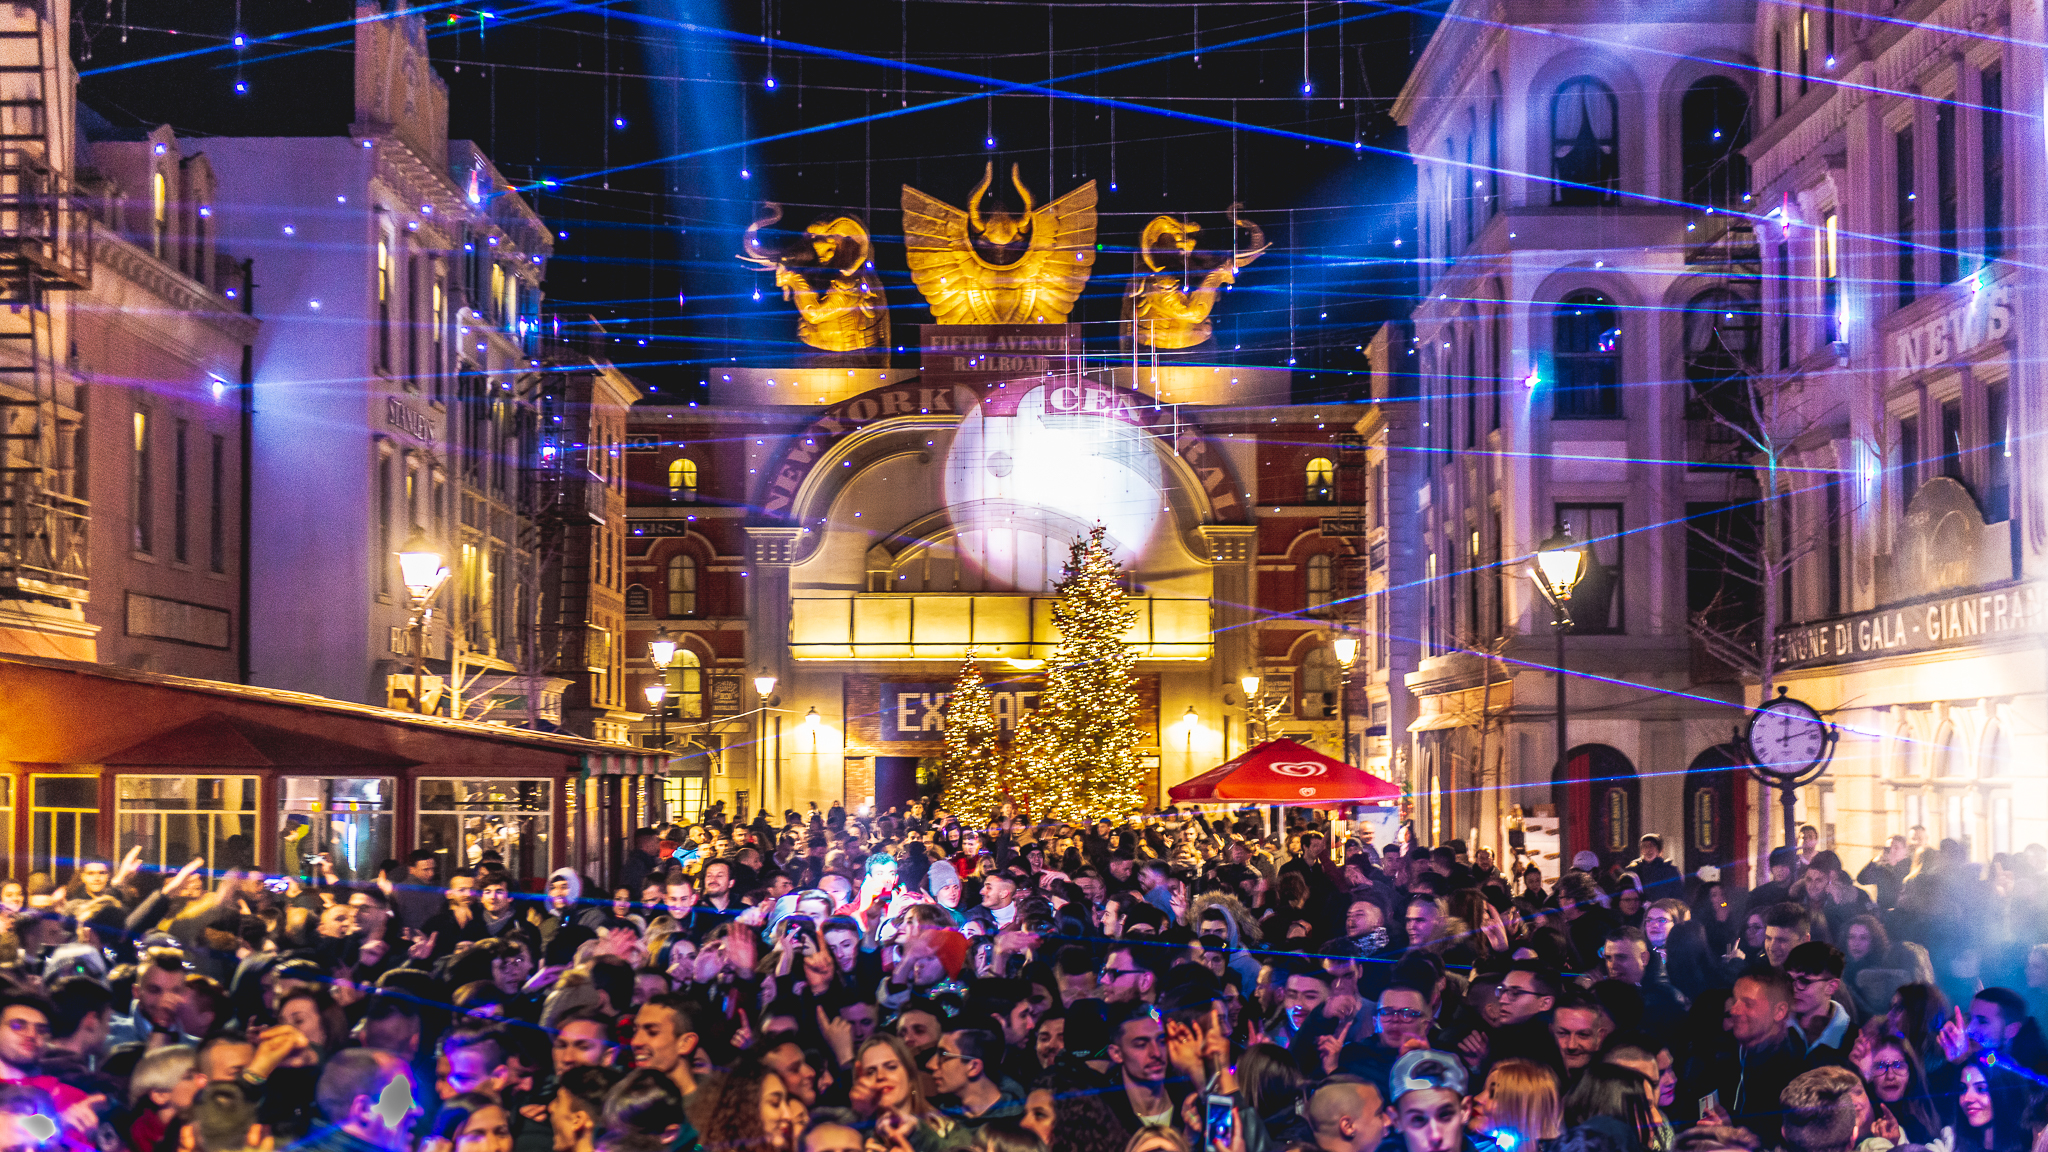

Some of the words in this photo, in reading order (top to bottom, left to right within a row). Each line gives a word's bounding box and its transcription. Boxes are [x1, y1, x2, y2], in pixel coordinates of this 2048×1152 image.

[930, 335, 988, 351] FIFTH
[1896, 284, 2012, 379] NEWS
[953, 356, 1050, 372] RAILROAD
[761, 437, 820, 520] NEW
[817, 388, 951, 437] YORK
[1835, 622, 1853, 656] DI
[1858, 613, 1907, 652] GALA
